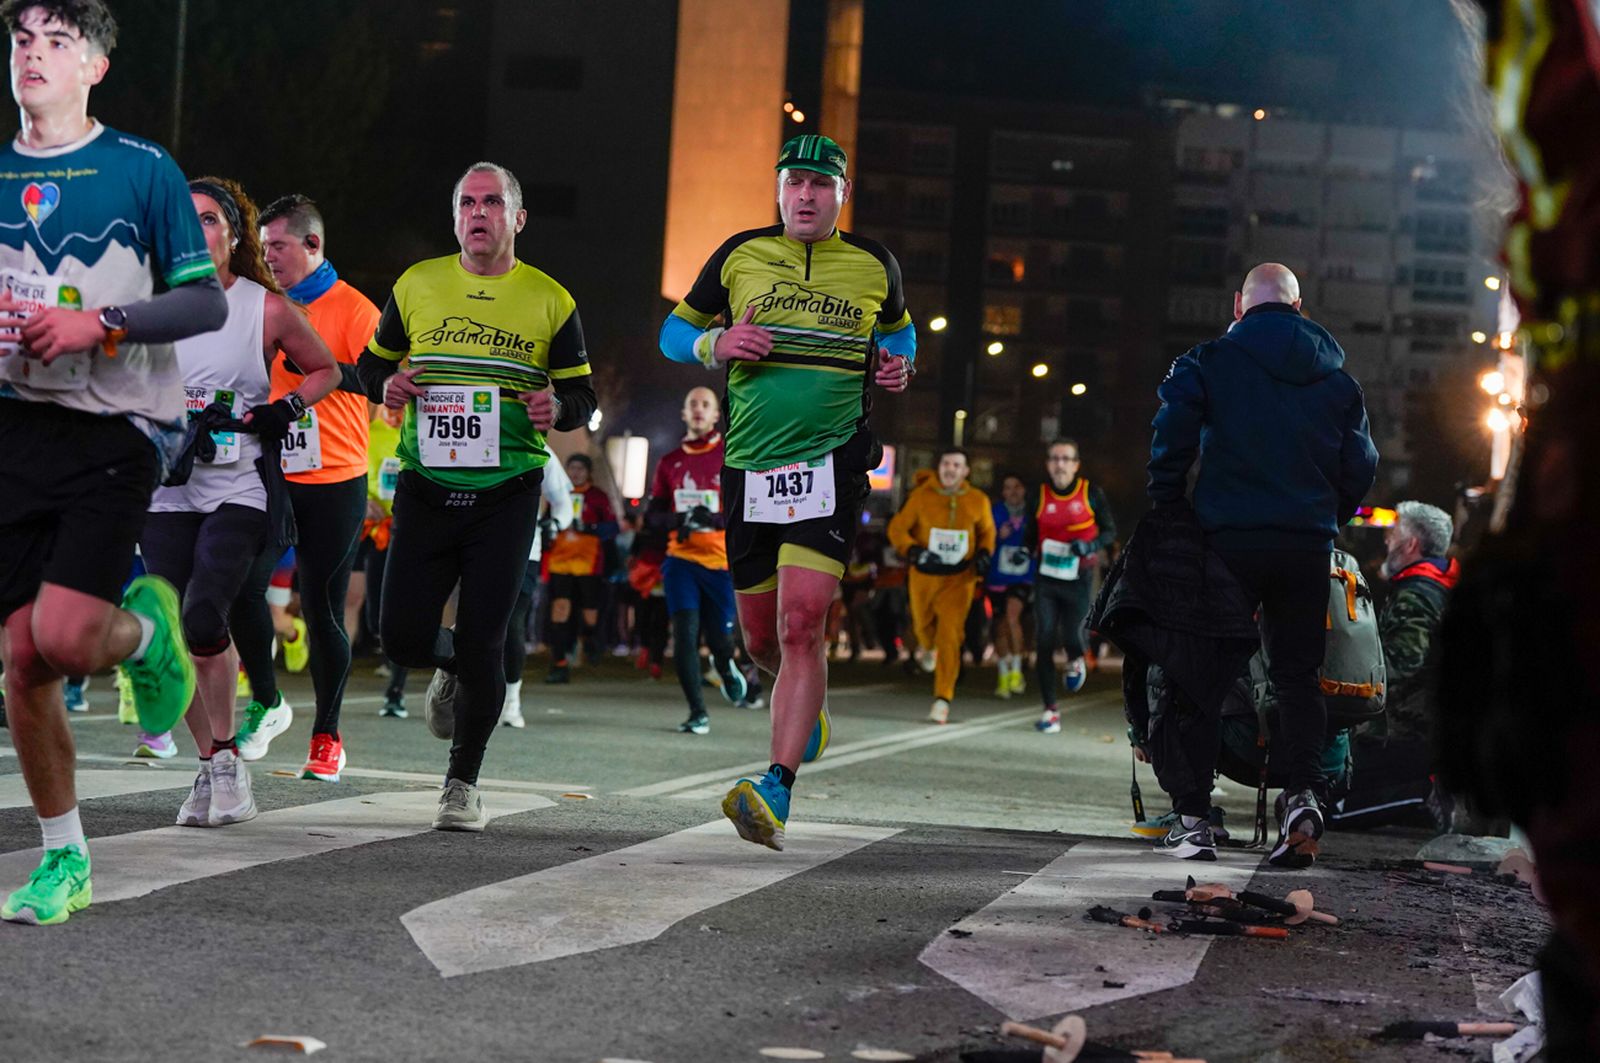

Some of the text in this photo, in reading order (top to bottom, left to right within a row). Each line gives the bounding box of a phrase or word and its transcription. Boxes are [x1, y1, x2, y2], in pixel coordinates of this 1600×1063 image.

[423, 403, 436, 414] SAN
[430, 394, 453, 403] NOCHE
[454, 394, 465, 404] DE
[427, 415, 481, 440] 7596
[281, 431, 307, 451] 04
[765, 470, 814, 498] 7437
